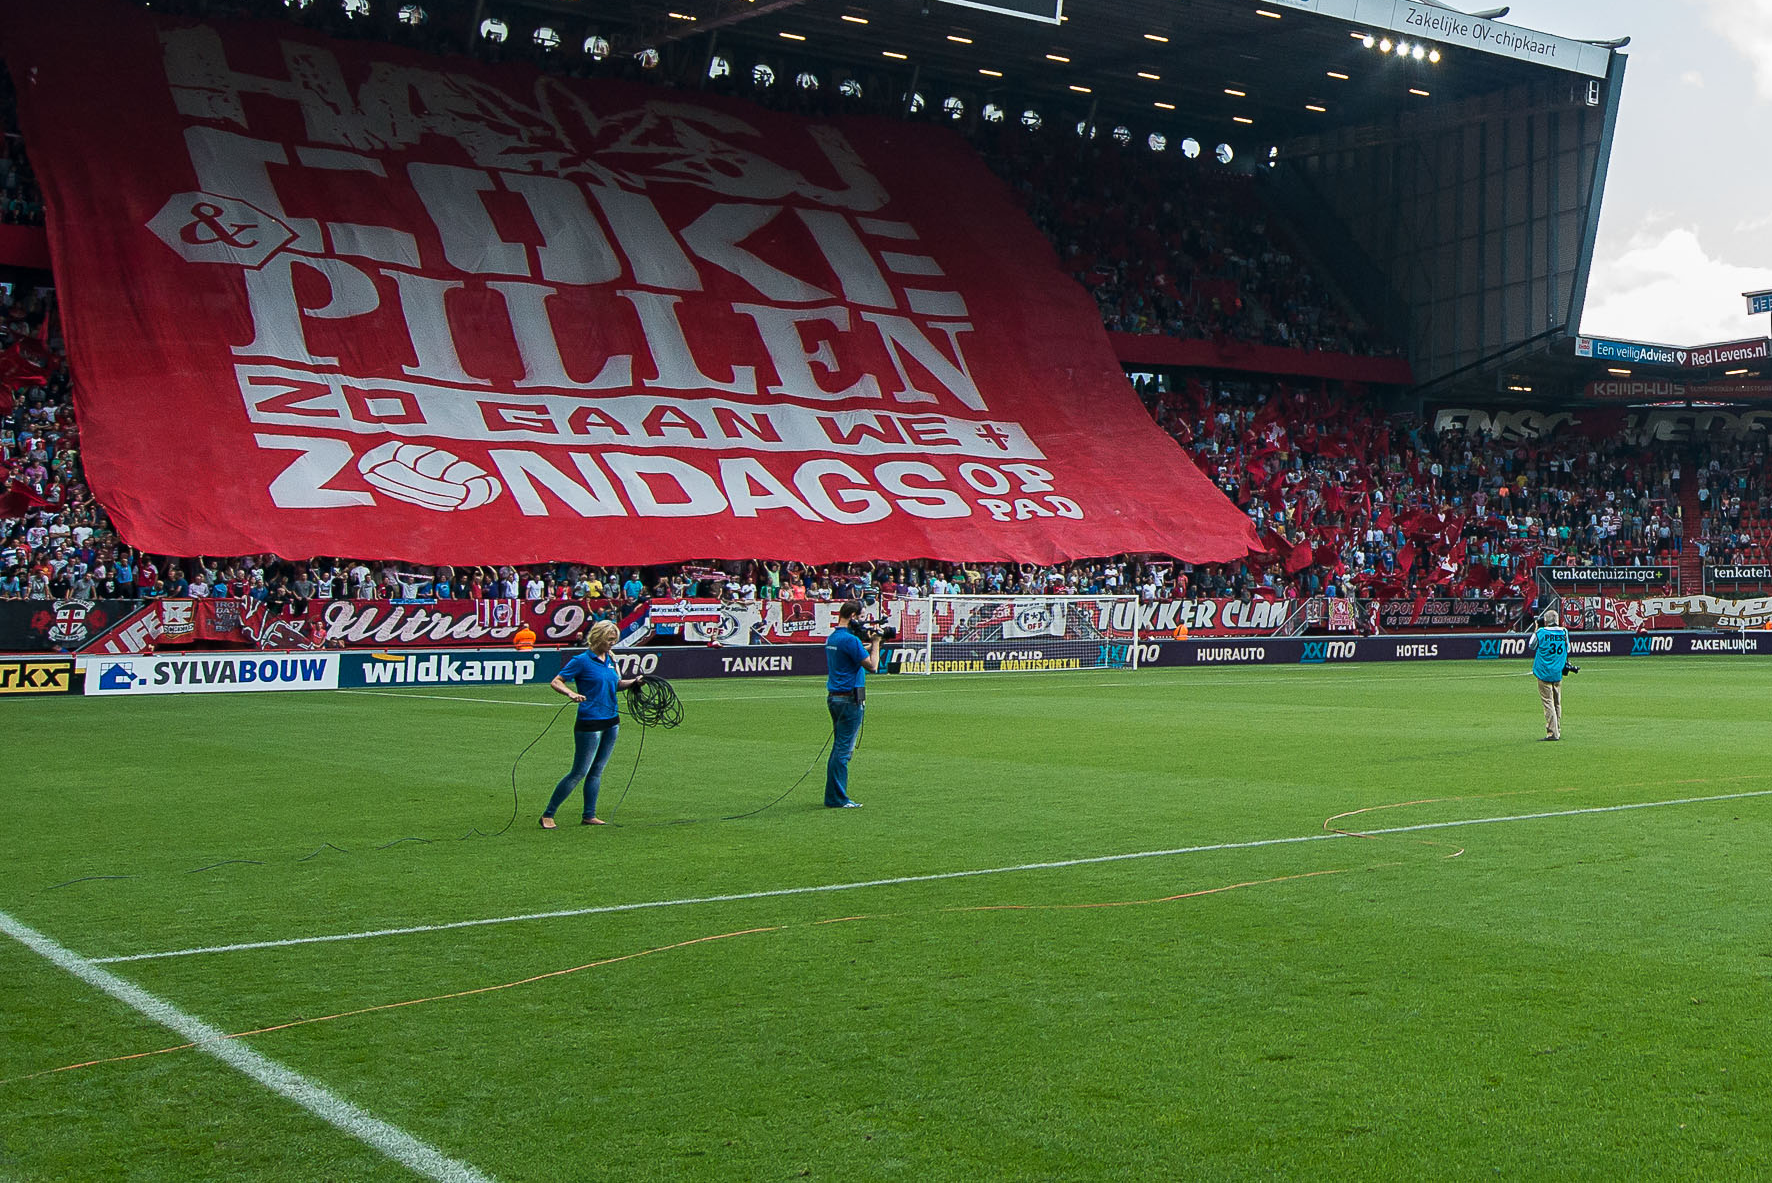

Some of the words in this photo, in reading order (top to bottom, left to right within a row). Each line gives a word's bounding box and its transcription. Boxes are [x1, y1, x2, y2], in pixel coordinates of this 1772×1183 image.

[1405, 8, 1469, 38] Zakelijke
[1472, 23, 1557, 58] OV-chipkaart
[231, 247, 991, 413] PILLEN
[1597, 342, 1614, 356] Een
[1691, 351, 1713, 366] Red
[1714, 342, 1767, 363] Levens.nl
[1593, 382, 1685, 396] KAMPHUIS
[247, 374, 412, 425] ZO
[476, 400, 774, 440] GAAN
[816, 416, 962, 449] WE
[958, 462, 1056, 496] OP
[988, 494, 1086, 523] PAD
[1098, 599, 1217, 630] TUKKER
[1221, 599, 1290, 629] CLAN
[1545, 633, 1566, 642] PRESS
[1690, 638, 1757, 651] ZAKENLUNCH
[1197, 647, 1265, 661] HUURAUTO
[1396, 644, 1438, 657] HOTELS
[1549, 643, 1564, 655] 36
[1567, 641, 1611, 653] OWASSEN
[363, 654, 536, 684] wildkamp
[722, 655, 793, 672] TANKEN
[900, 660, 985, 673] AVANTISPORT.NL
[1000, 658, 1081, 671] AVANTISPORT.NL
[154, 659, 328, 685] SYLVABOUW
